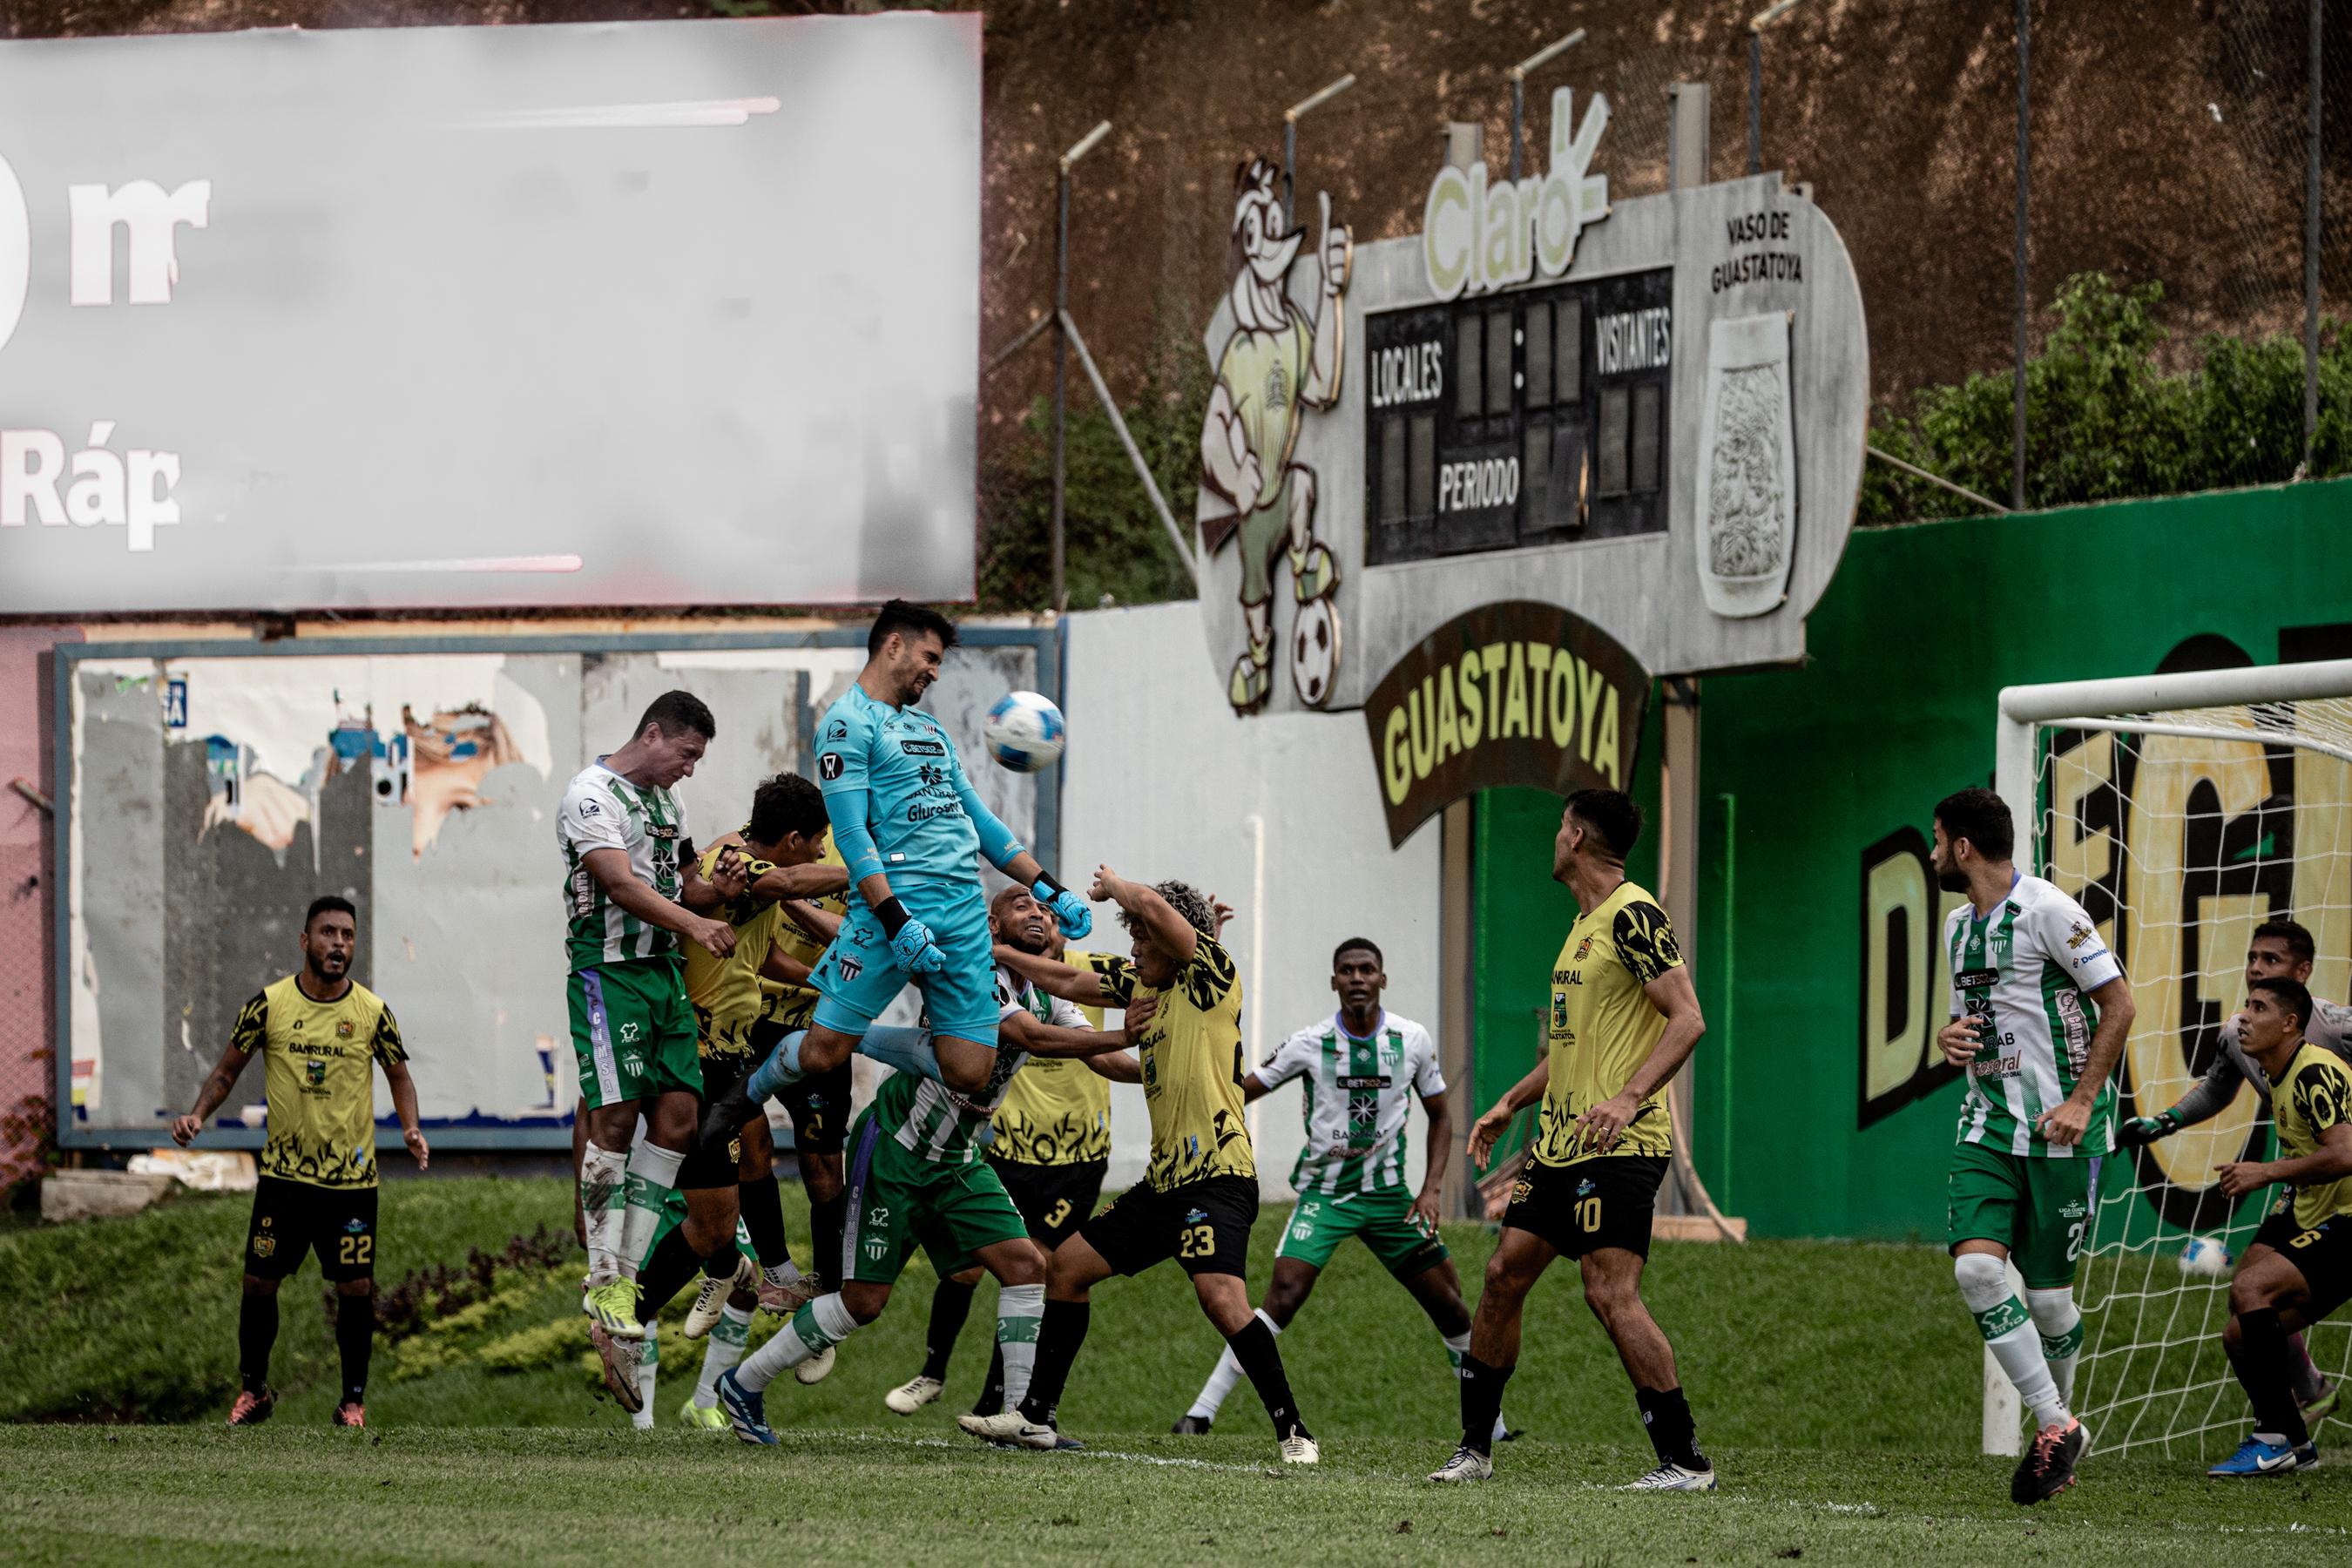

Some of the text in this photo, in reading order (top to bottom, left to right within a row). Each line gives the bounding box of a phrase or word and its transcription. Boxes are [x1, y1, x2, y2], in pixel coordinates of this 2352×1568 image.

[1424, 161, 1577, 301] Claro
[1727, 211, 1789, 247] VASO DE
[1711, 252, 1802, 294] GUASTATOYA
[1371, 340, 1443, 408] LOCALES
[1438, 456, 1520, 513] PERIODO
[1384, 641, 1620, 807] GUASTATOYA
[1044, 1198, 1072, 1228] 3
[1574, 1197, 1602, 1233] 10
[340, 1235, 372, 1264] 22
[1180, 1225, 1215, 1258] 23
